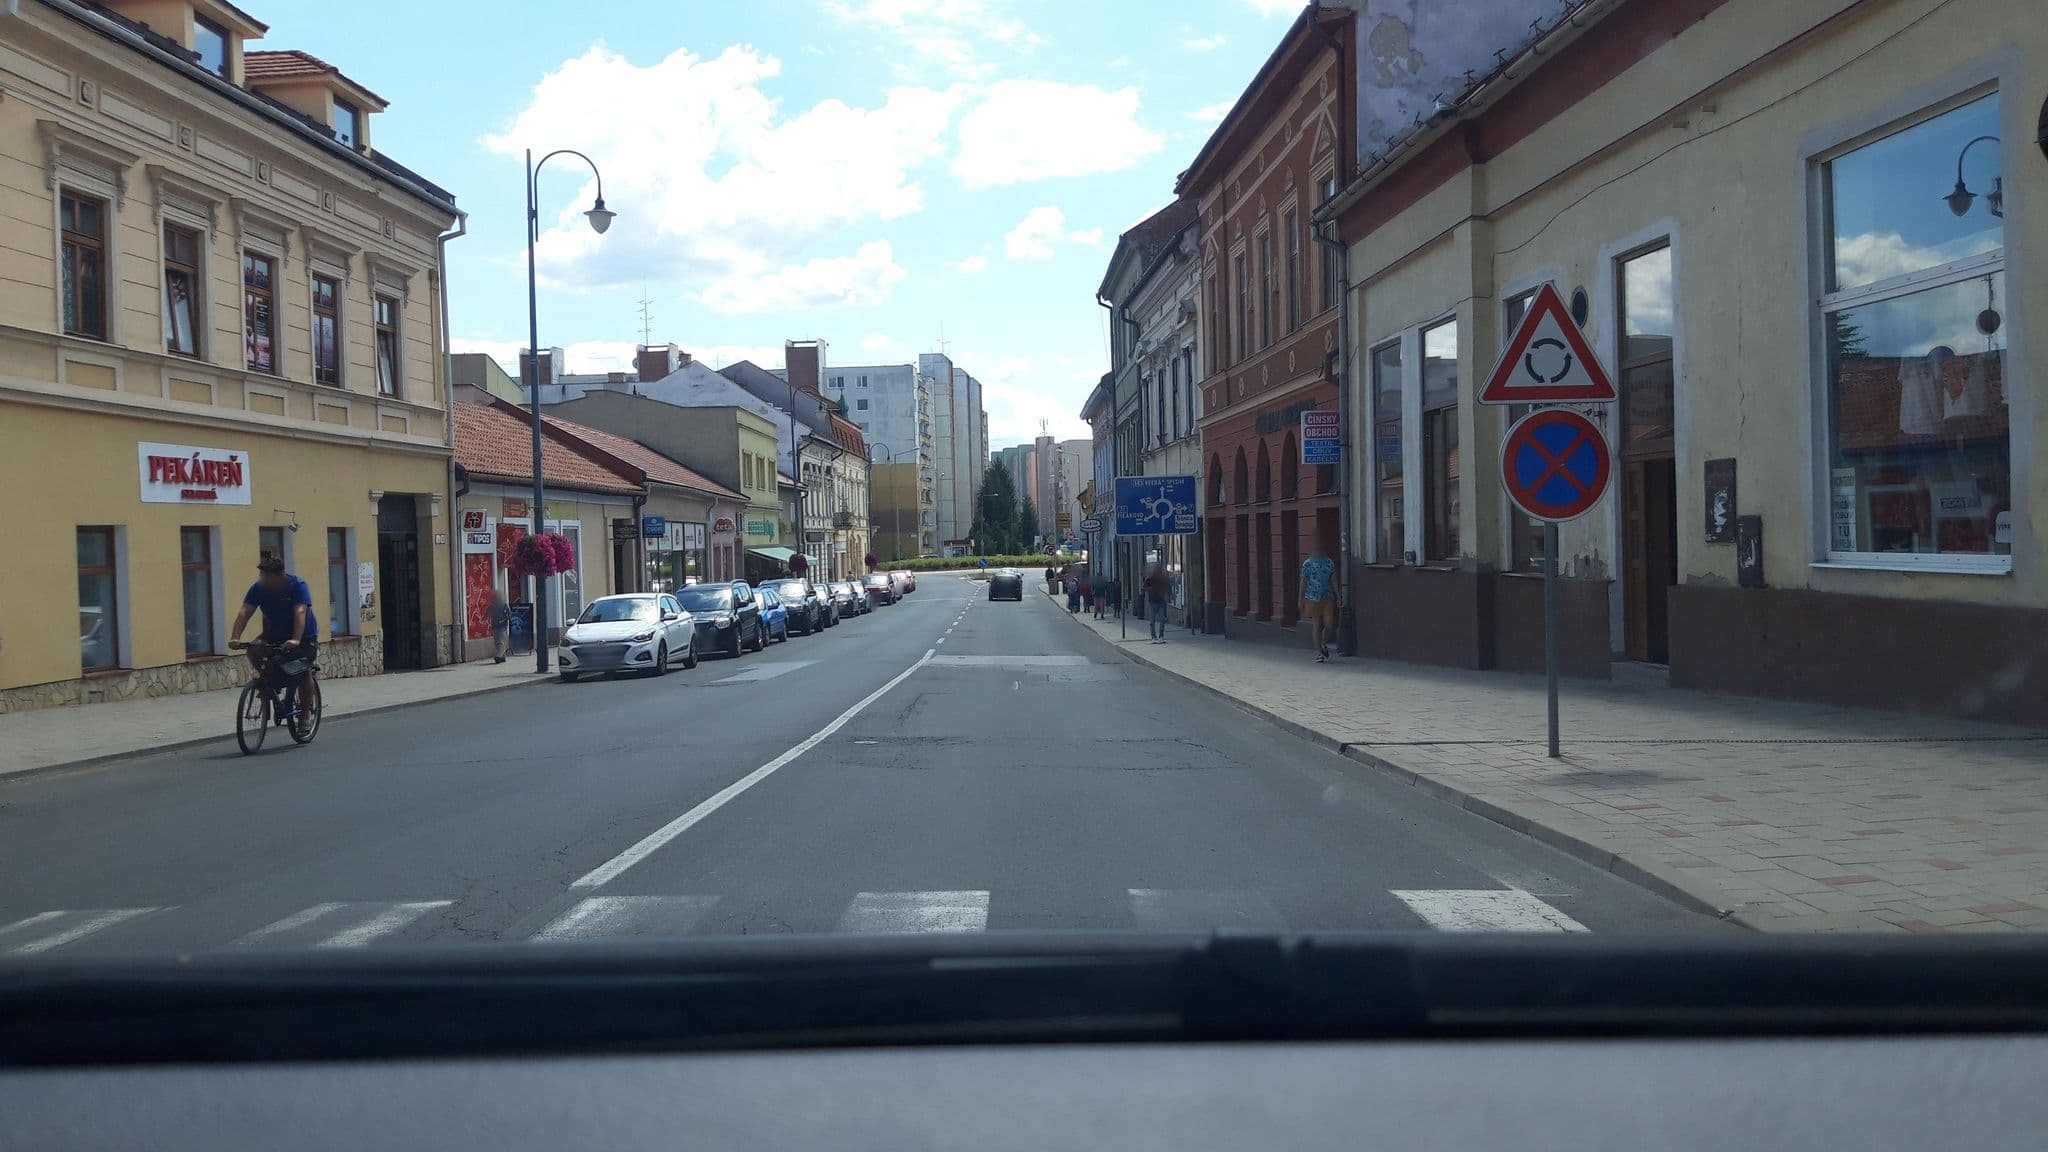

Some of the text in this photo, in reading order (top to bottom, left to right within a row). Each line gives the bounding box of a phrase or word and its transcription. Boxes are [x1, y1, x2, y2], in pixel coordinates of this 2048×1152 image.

[1305, 427, 1337, 437] OBCHOD
[147, 452, 243, 486] PEKÁREŇ
[473, 534, 490, 543] TIPOS
